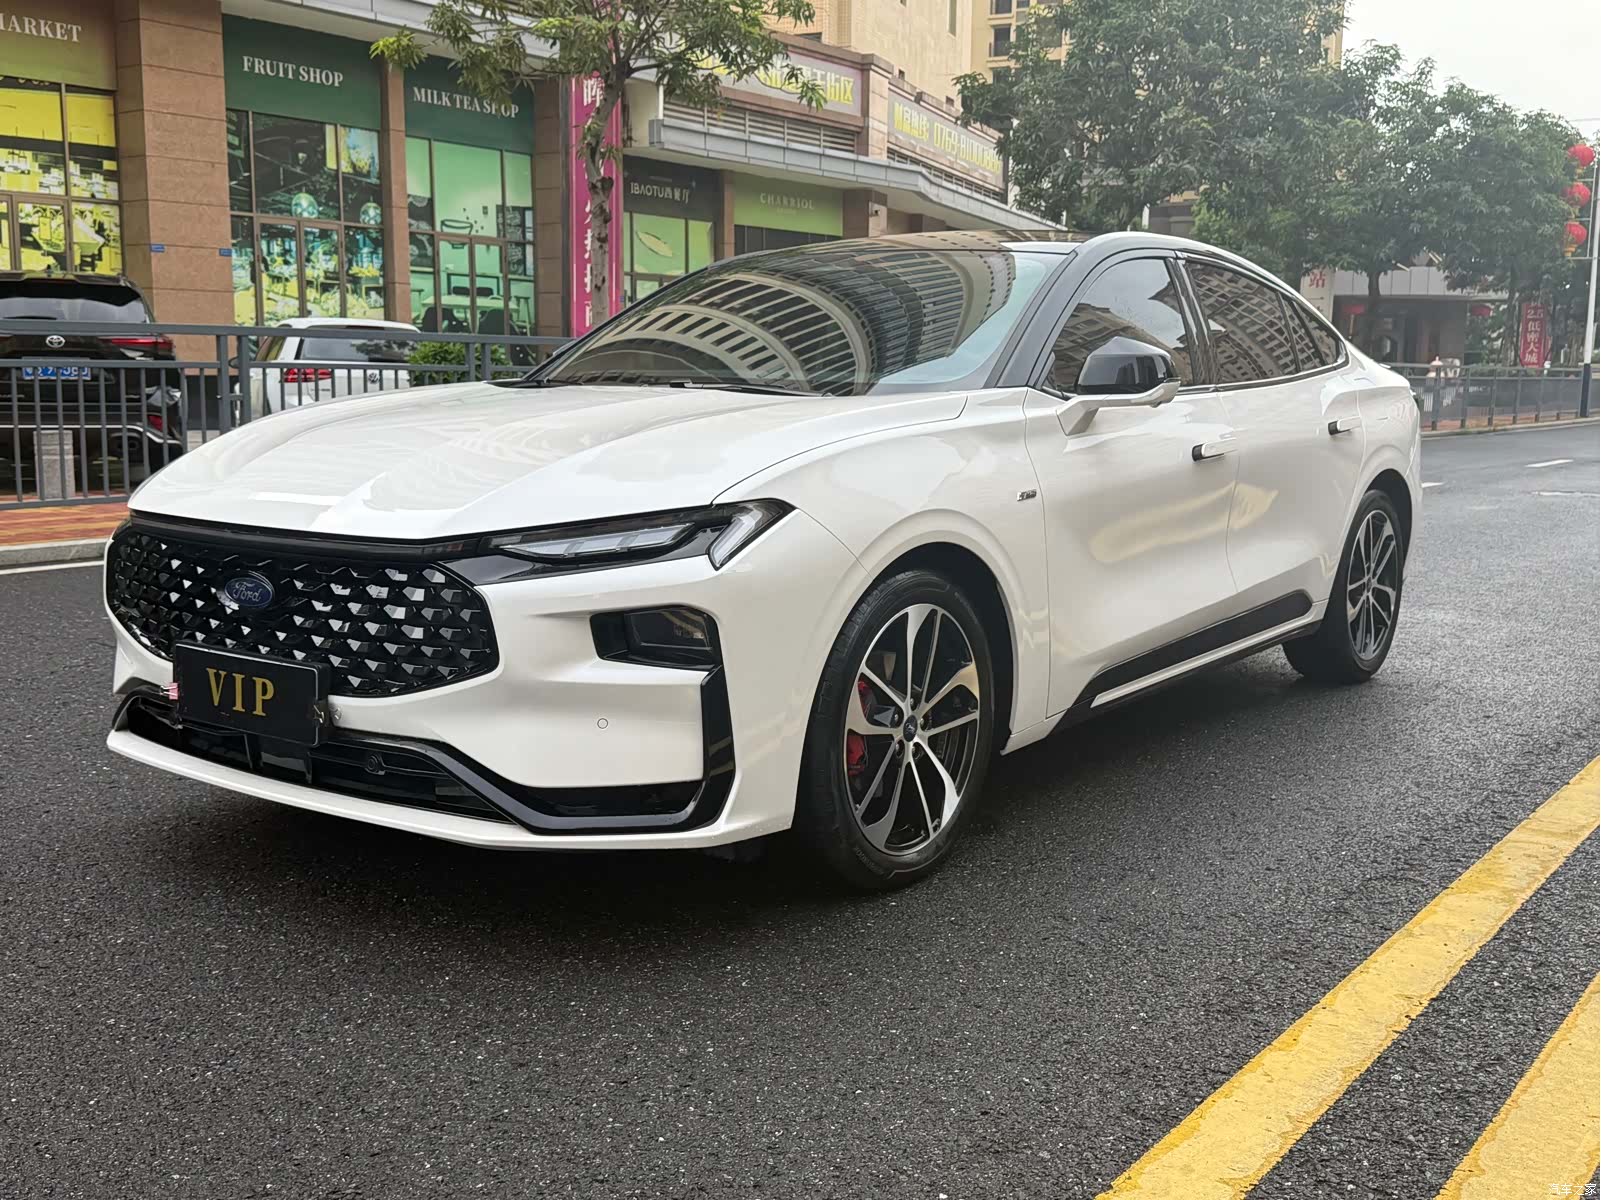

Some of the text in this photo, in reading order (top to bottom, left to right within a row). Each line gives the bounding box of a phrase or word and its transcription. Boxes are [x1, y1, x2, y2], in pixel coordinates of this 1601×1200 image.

[0, 13, 82, 42] ARKET
[242, 55, 344, 87] FRUIT SHOP
[413, 86, 452, 107] MILK
[453, 93, 481, 112] TEA
[233, 582, 264, 603] Ford
[206, 667, 275, 717] VIP
